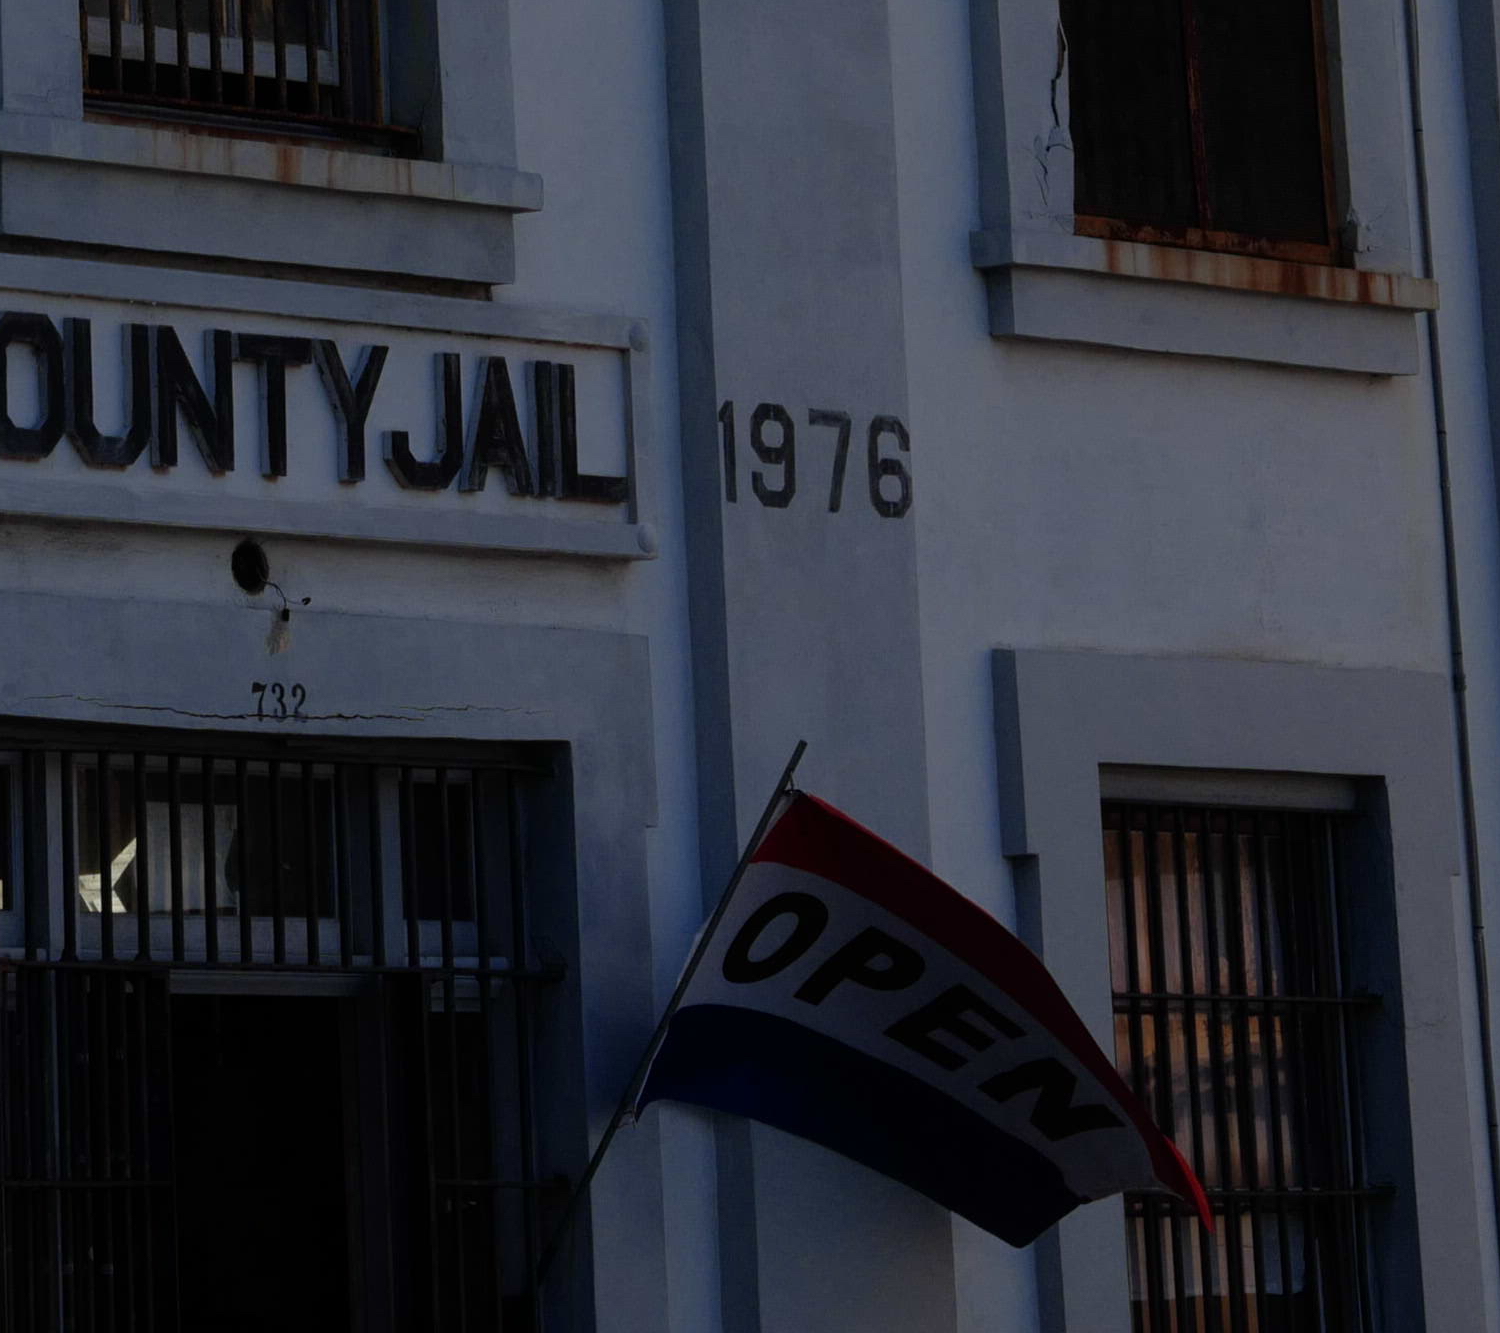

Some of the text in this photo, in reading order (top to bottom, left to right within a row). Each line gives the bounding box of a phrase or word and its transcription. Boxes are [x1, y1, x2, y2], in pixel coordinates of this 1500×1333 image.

[382, 351, 629, 504] JAIL
[718, 399, 913, 519] 1976
[251, 681, 308, 724] 732
[721, 891, 1127, 1143] OPEN
